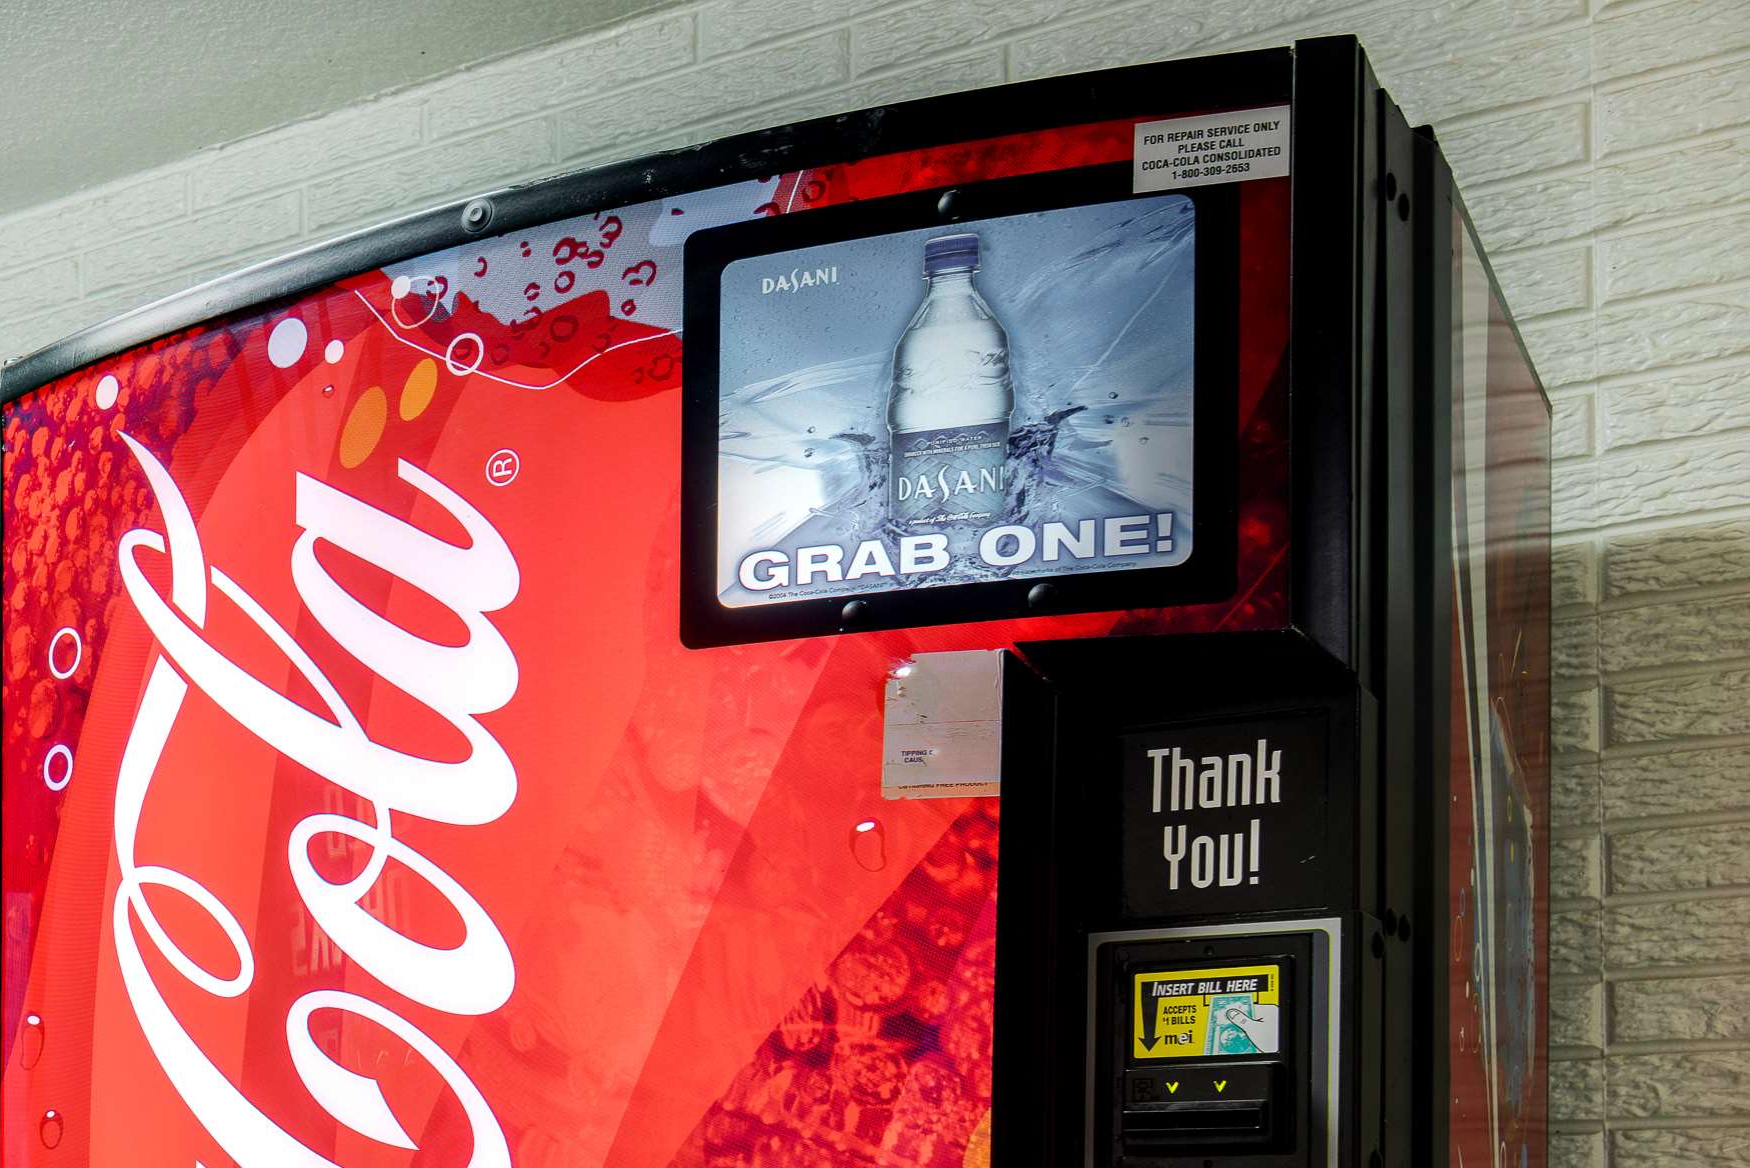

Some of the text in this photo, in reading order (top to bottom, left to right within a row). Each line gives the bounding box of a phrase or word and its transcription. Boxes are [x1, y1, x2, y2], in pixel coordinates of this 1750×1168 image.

[1143, 120, 1280, 146] FOR REPAIR SERVICE ONLY
[1142, 146, 1281, 171] COCA-COLA CONSOLIDATED
[1178, 138, 1245, 154] PLEASE CALL
[1171, 162, 1250, 180] 1-800-309-2653
[761, 267, 837, 295] DASANI
[898, 464, 1004, 503] DASANI
[738, 512, 1174, 591] GRAB ONE!
[1147, 739, 1282, 813] Thank
[1162, 818, 1261, 890] You!
[1152, 981, 1195, 997] INSERT
[1197, 980, 1223, 994] BILL
[1226, 978, 1258, 992] HERE
[1162, 1004, 1197, 1015] ACCEPTS
[1171, 1015, 1196, 1025] BILLS
[1164, 1029, 1193, 1046] mei
